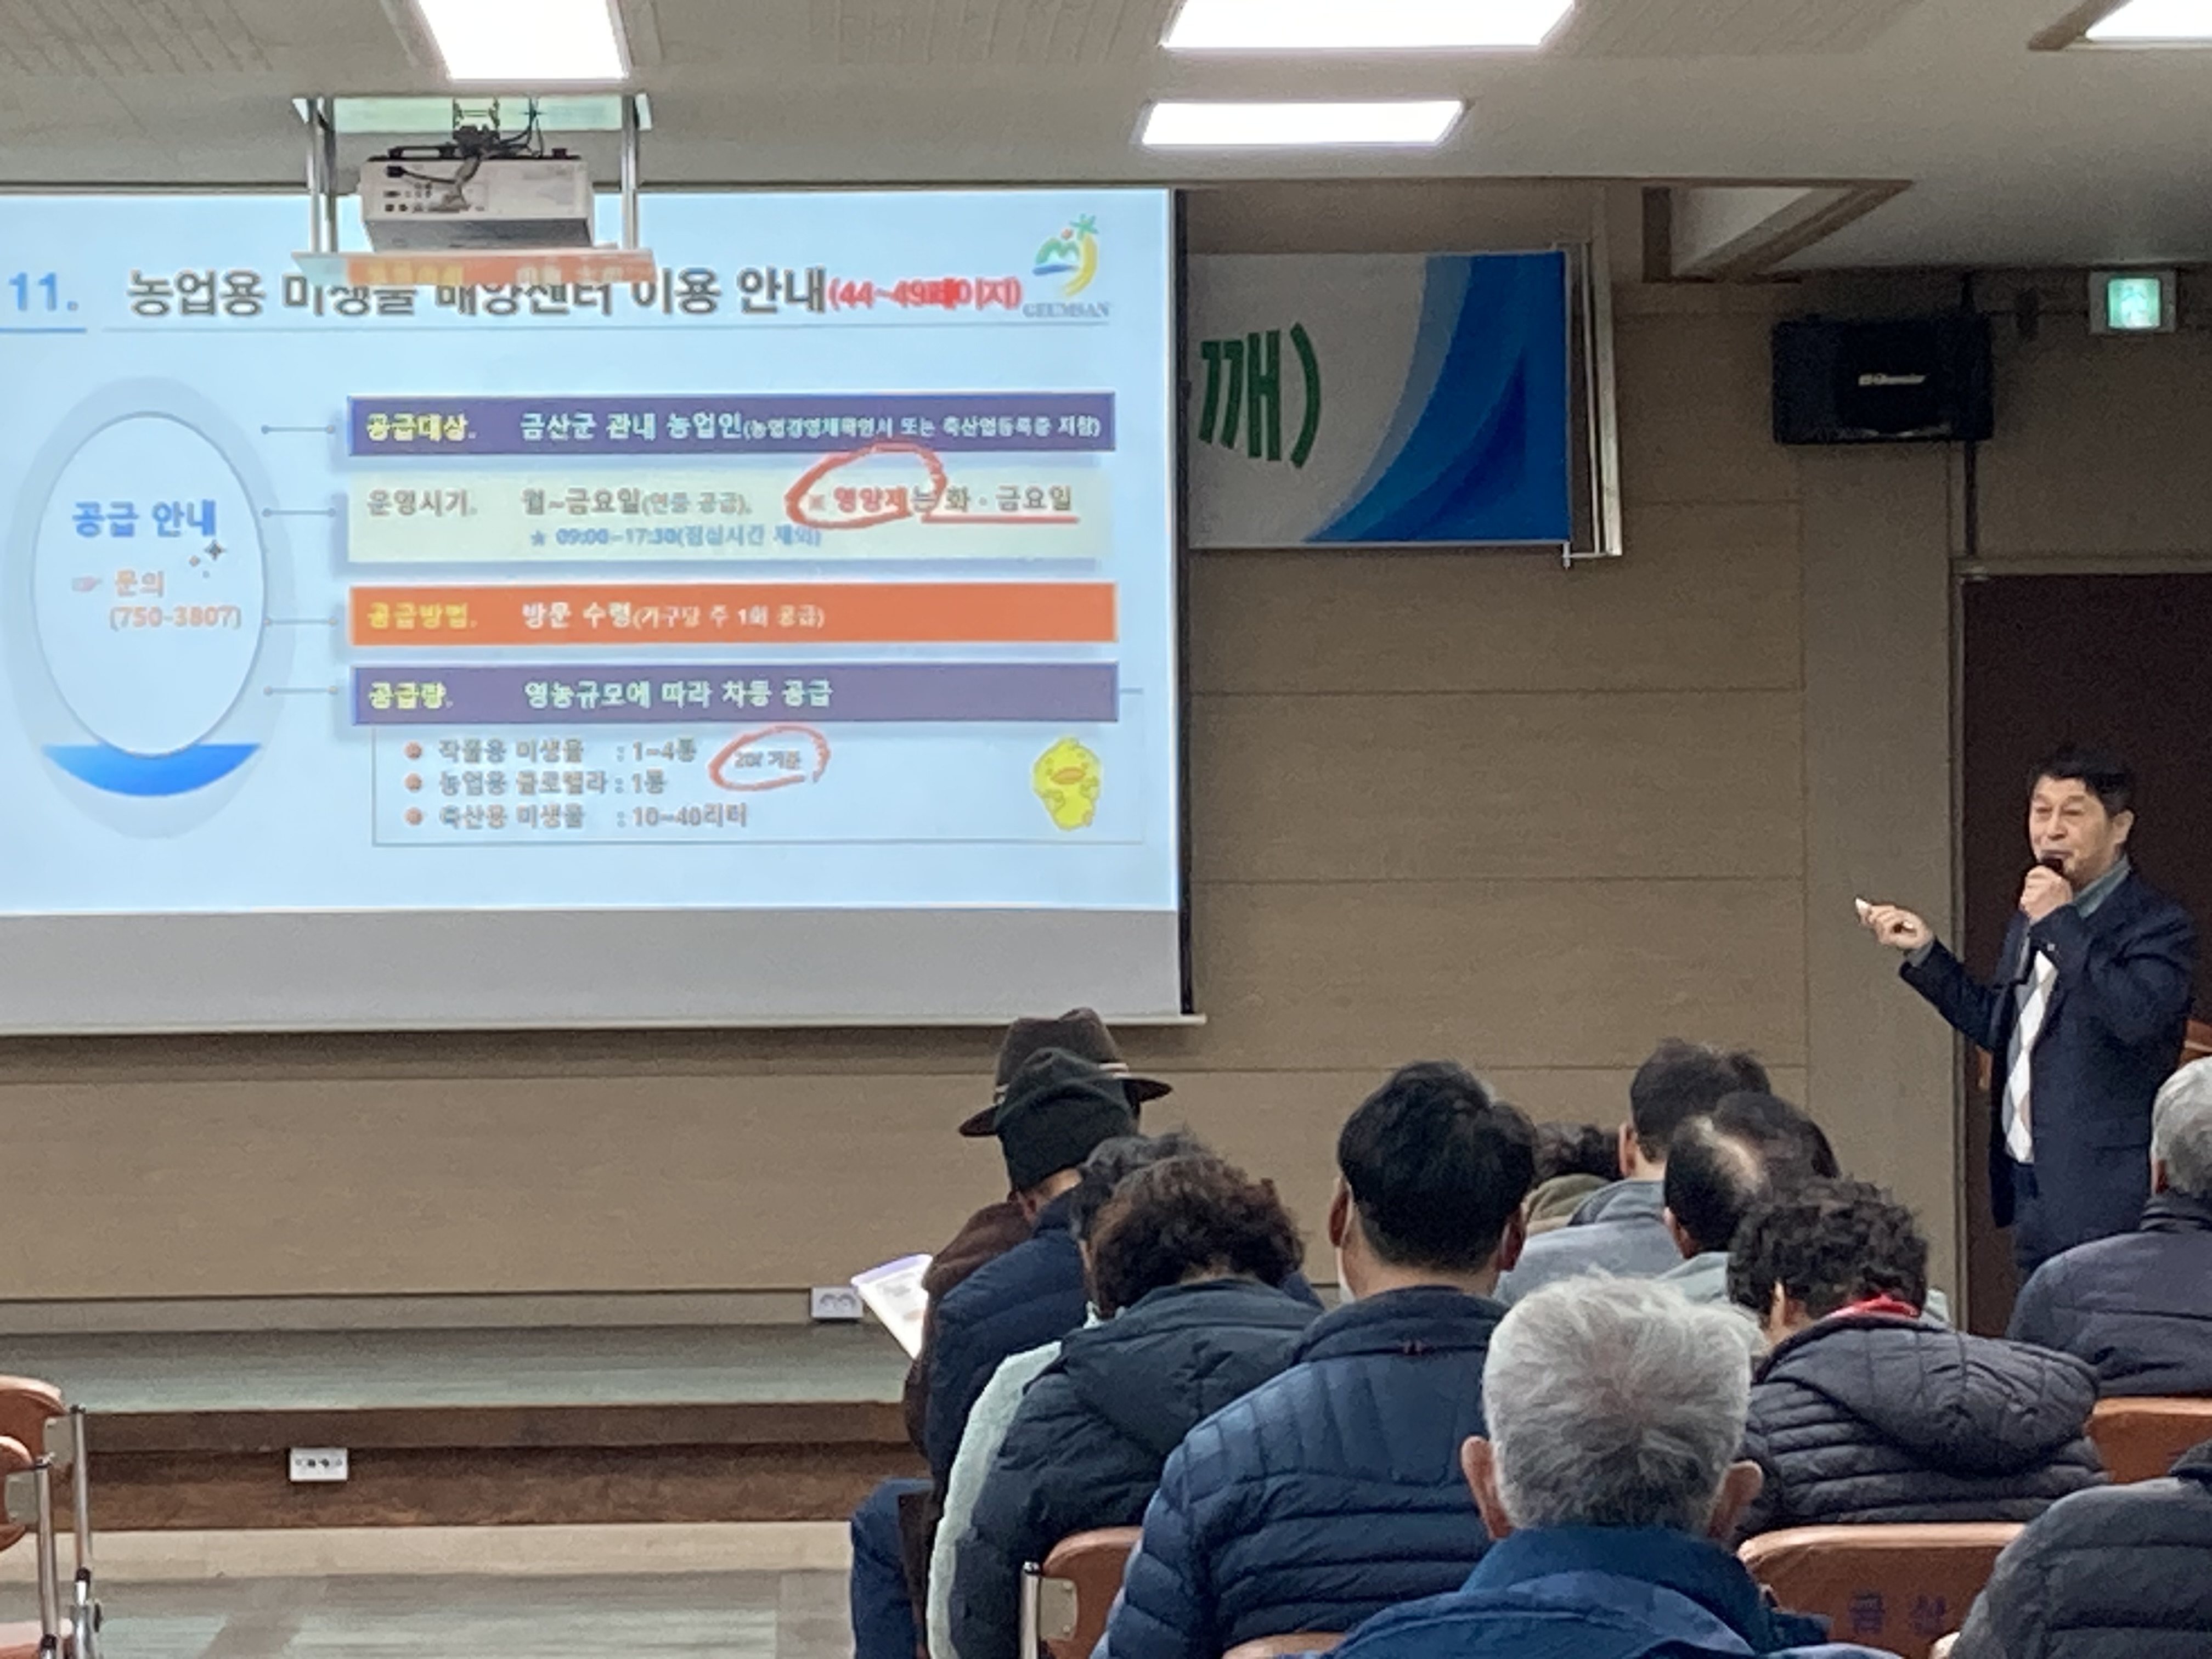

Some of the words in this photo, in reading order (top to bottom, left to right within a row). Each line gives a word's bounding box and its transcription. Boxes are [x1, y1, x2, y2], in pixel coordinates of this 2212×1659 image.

[9, 272, 78, 311] 11.
[127, 269, 265, 317] 농업용
[631, 267, 721, 314] 이용
[520, 412, 597, 441] 금산군
[606, 412, 657, 441] 관내
[901, 416, 935, 437] 또는
[945, 486, 970, 512] 화
[996, 484, 1072, 511] 금요일
[72, 500, 139, 538] 공급
[152, 499, 216, 538] 안내
[115, 569, 164, 598] 문의
[109, 605, 241, 631] (750-3807)
[523, 601, 571, 630] 방문
[710, 605, 729, 628] 주
[738, 605, 769, 628] 1회
[778, 605, 825, 629] 공급)
[524, 680, 651, 709] 영농규모에
[661, 680, 713, 709] 따라
[721, 680, 772, 709] 차등
[782, 680, 833, 709] 공급
[516, 737, 584, 764] 미생물
[439, 770, 507, 796] 농업용
[439, 803, 507, 830] 축산용
[516, 803, 584, 829] 미생물
